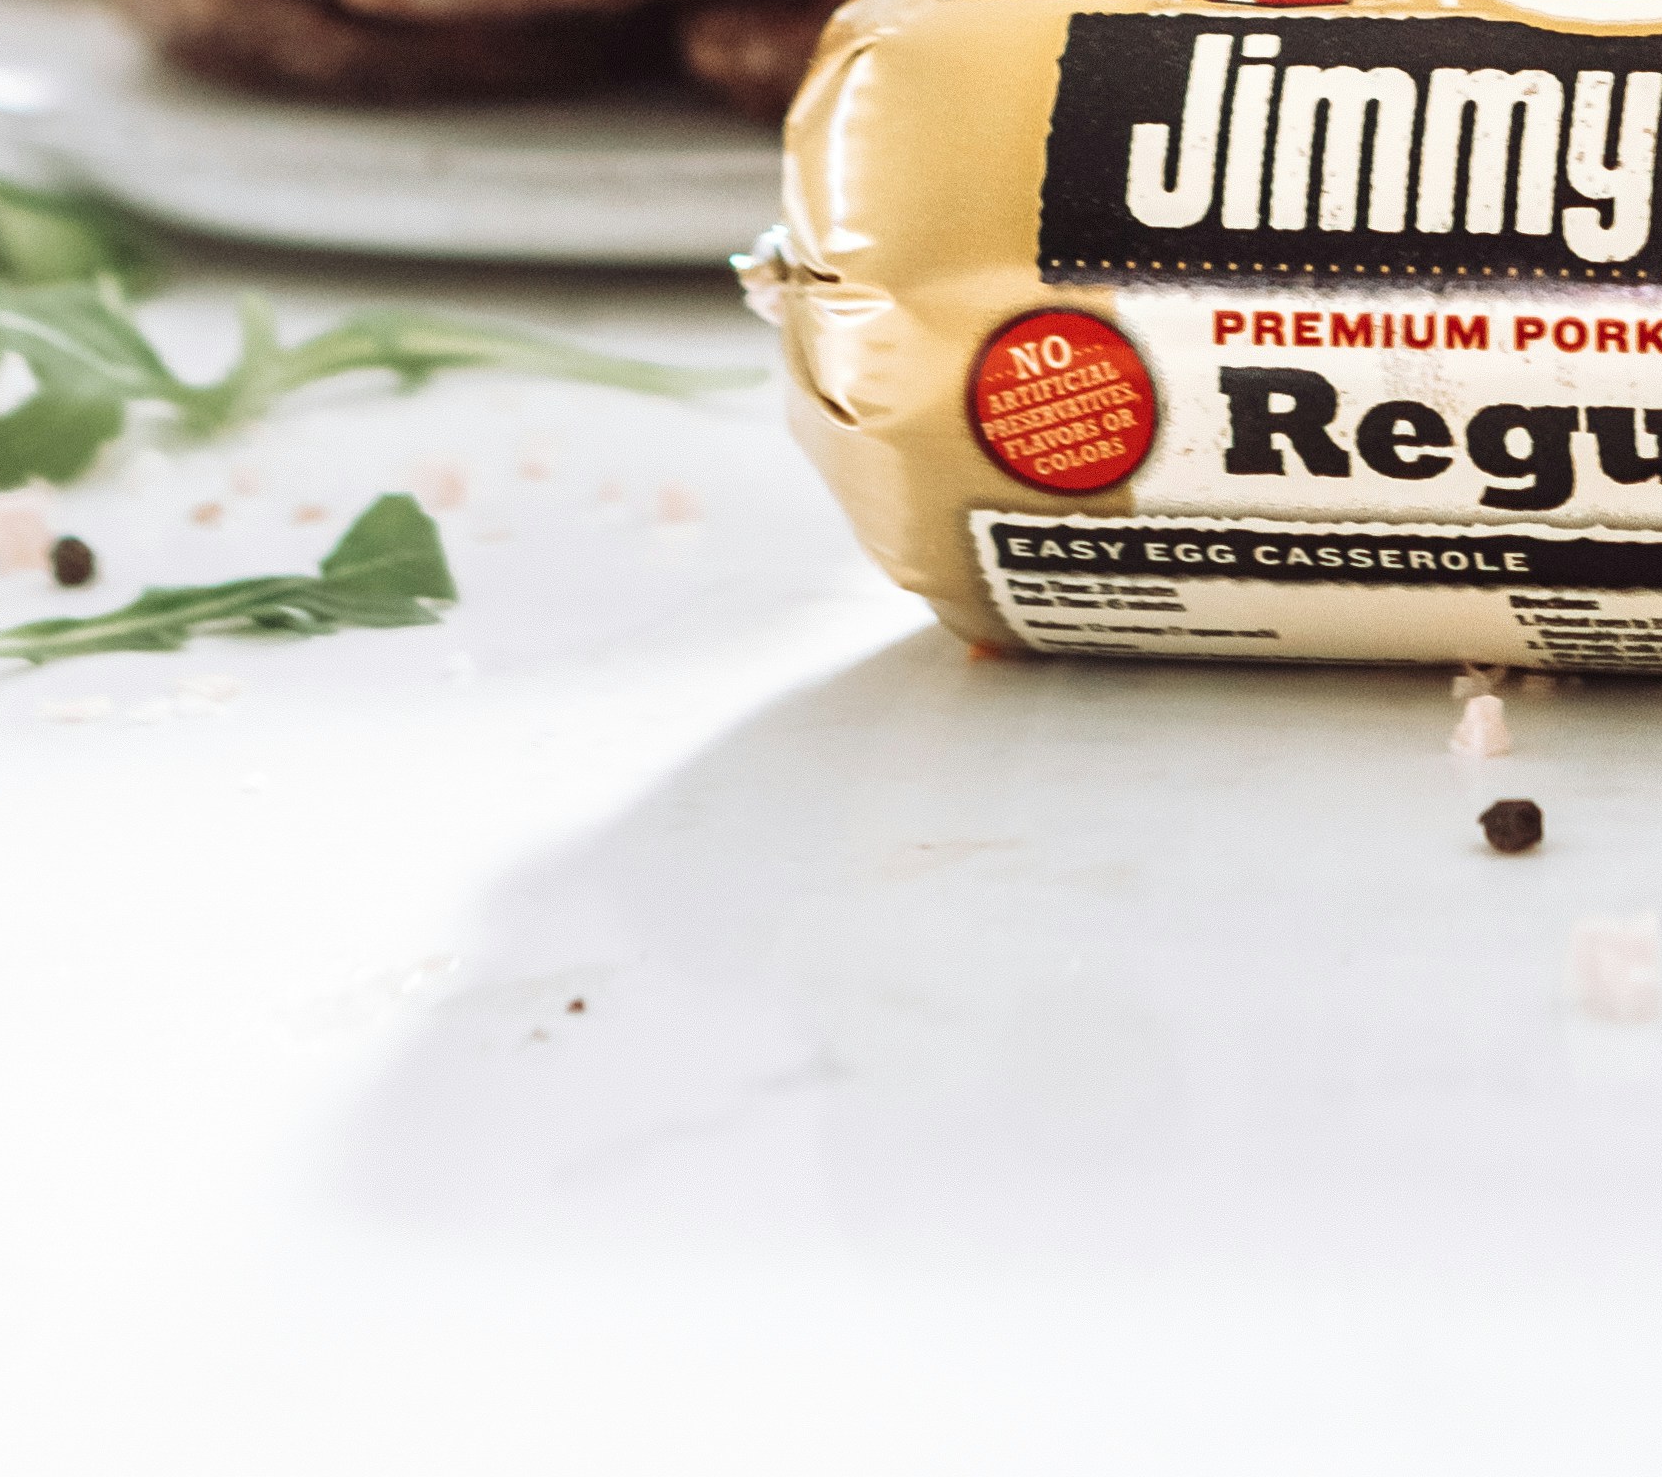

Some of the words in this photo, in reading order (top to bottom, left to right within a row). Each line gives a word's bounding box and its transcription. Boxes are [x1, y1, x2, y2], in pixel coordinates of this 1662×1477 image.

[1212, 309, 1490, 352] PREMIUM
[987, 361, 1121, 415] ARTIFICIAL
[1001, 419, 1101, 460] FLAVORS
[1101, 408, 1138, 431] OR
[1033, 436, 1127, 476] COLORS
[1006, 537, 1127, 562] EASY
[1143, 543, 1237, 565] EGG
[1252, 545, 1531, 574] CASSEROLE
